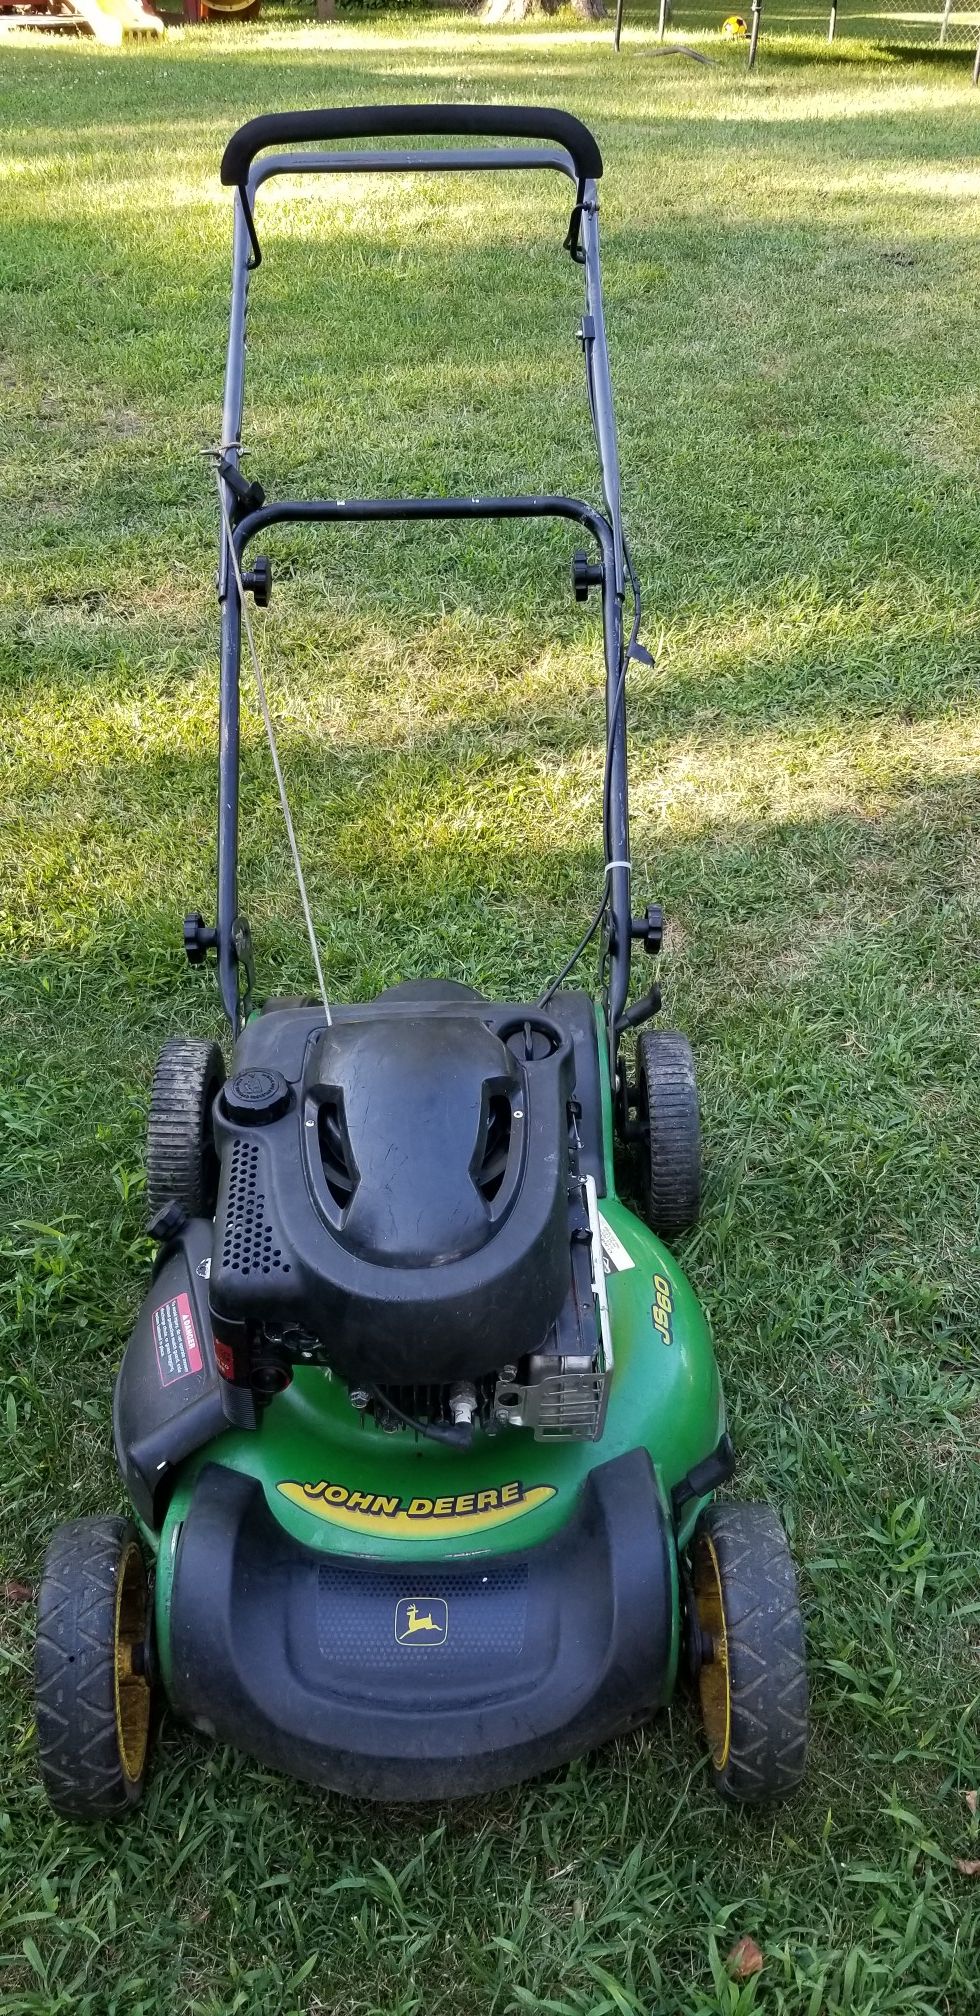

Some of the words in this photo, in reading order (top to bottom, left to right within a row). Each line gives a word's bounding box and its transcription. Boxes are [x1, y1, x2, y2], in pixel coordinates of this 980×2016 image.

[652, 1273, 673, 1346] JS60
[183, 1319, 195, 1350] DANGER
[303, 1481, 400, 1516] JOHN
[407, 1482, 522, 1517] DEERE
